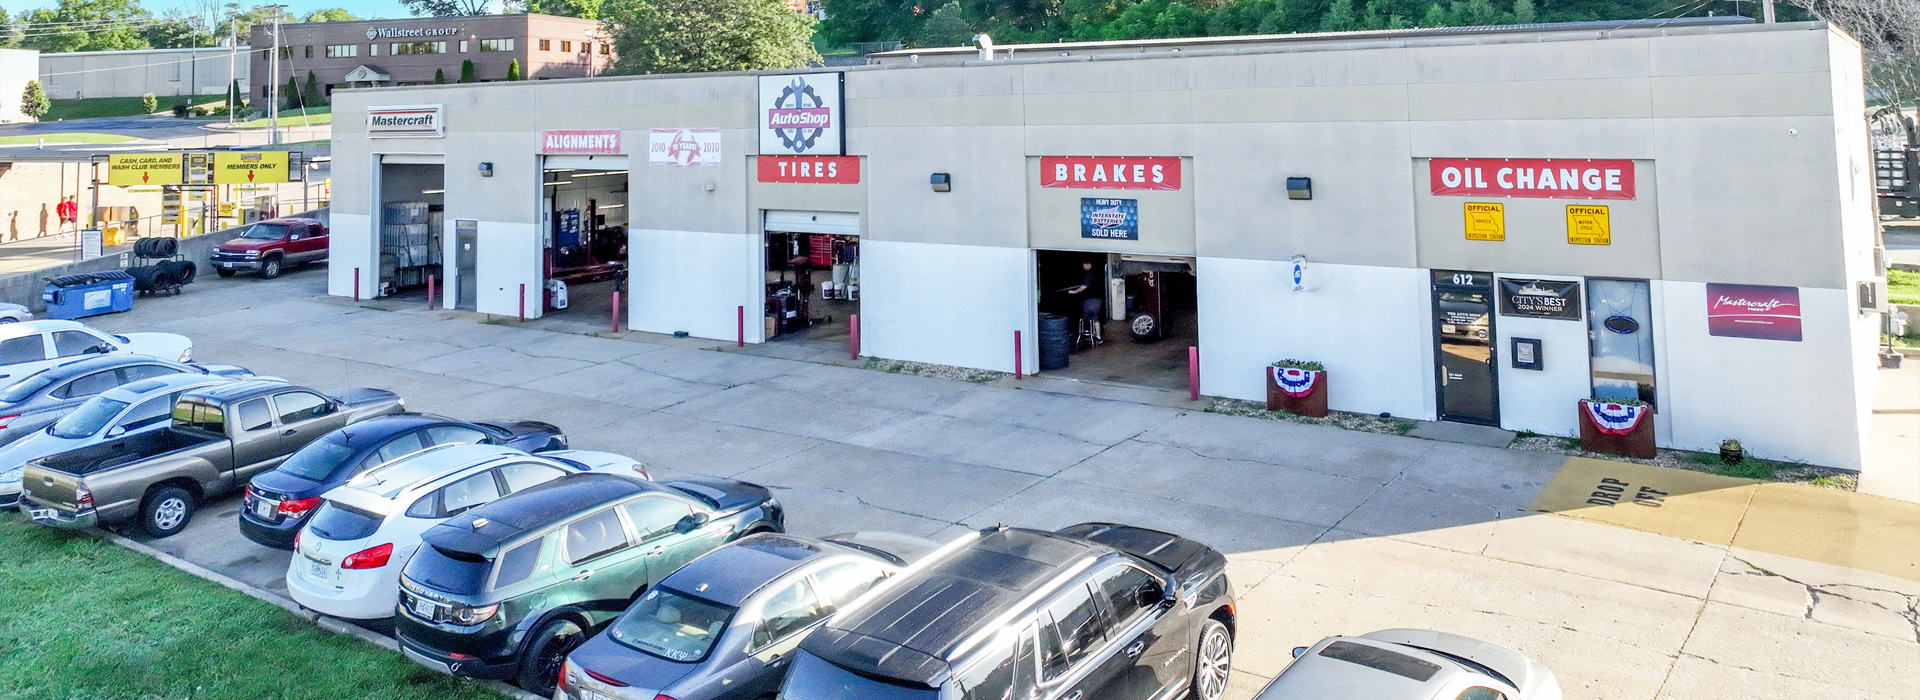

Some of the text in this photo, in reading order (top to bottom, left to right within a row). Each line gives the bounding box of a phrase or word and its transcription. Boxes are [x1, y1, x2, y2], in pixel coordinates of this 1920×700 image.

[378, 28, 458, 38] Wallstreet GROUP
[372, 114, 433, 126] Mastercraft
[771, 112, 828, 126] AutoShop
[546, 134, 616, 149] ALIGNMENTS
[651, 142, 666, 152] 2010
[703, 142, 720, 152] 2020
[778, 161, 837, 178] TIRES
[1055, 163, 1164, 183] BRAKES
[1441, 166, 1622, 191] OIL CHANGE
[1091, 229, 1128, 238] SOLD HERE
[1452, 273, 1474, 285] 612
[1511, 295, 1567, 306] CITY'S BEST
[1713, 295, 1780, 311] Mastercraft
[1586, 478, 1629, 507] DROP
[1632, 486, 1668, 508] OFF
[406, 582, 445, 600] DISCOVERY
